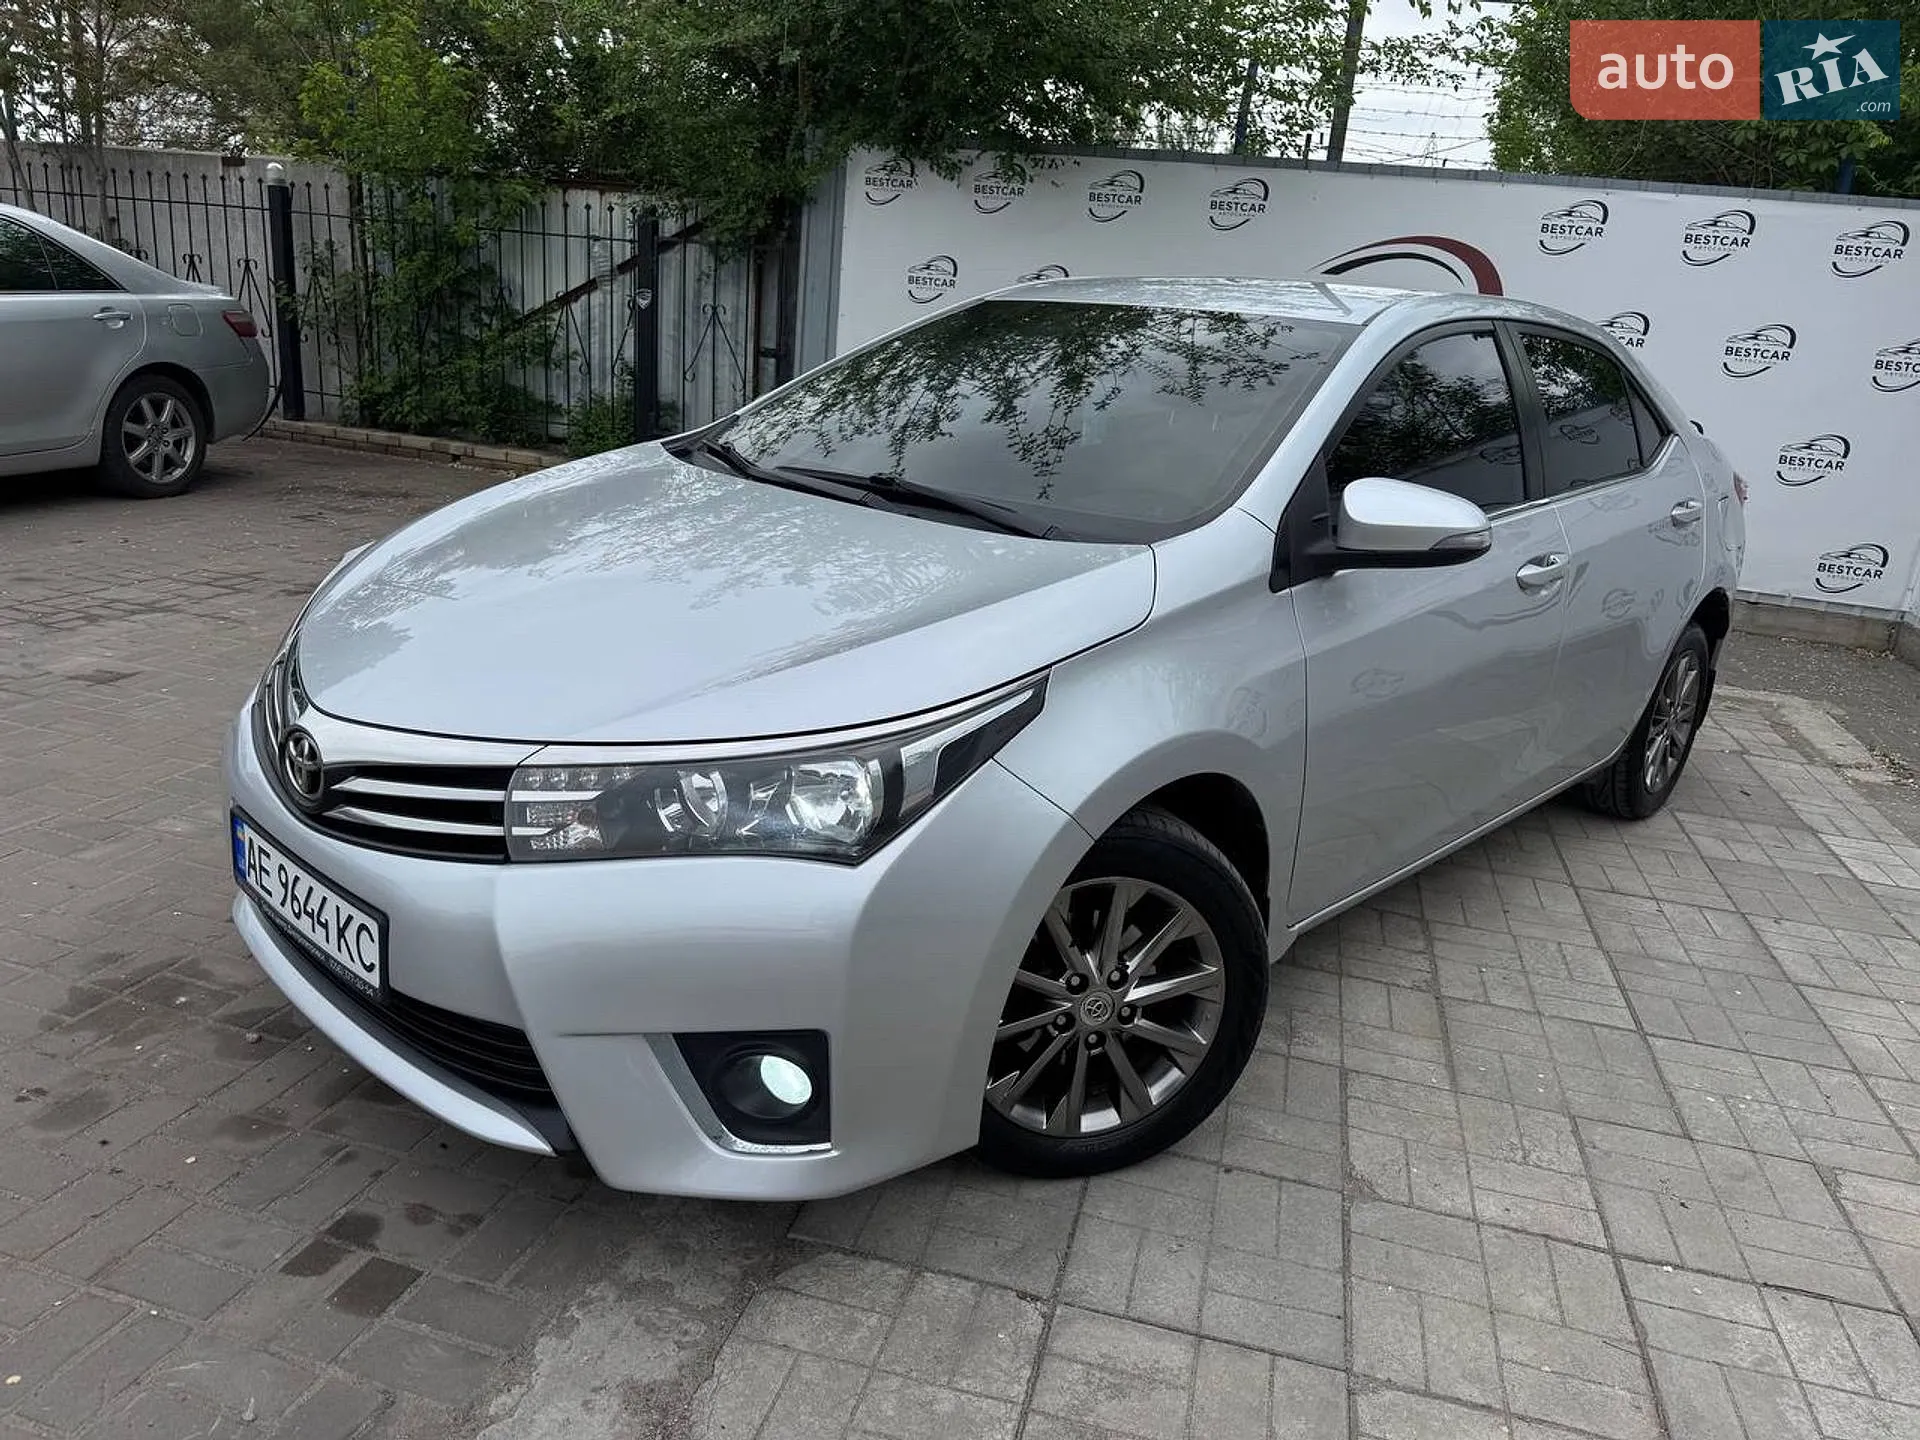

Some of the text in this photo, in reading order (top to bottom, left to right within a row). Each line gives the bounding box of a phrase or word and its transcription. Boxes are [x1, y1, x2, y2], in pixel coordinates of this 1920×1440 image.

[865, 177, 913, 189] BESTCAR
[973, 184, 1025, 197] BESTCAR
[1088, 192, 1142, 206] BESTCAR
[1210, 200, 1266, 214] BESTCAR
[1540, 223, 1604, 237] BESTCAR
[1684, 233, 1751, 248] BESTCAR
[1834, 244, 1904, 260] BESTCAR
[907, 276, 956, 289] BESTCAR
[1724, 346, 1791, 362] BESTCAR
[1778, 454, 1845, 471] BESTCAR
[1817, 562, 1883, 580] BESTCAR
